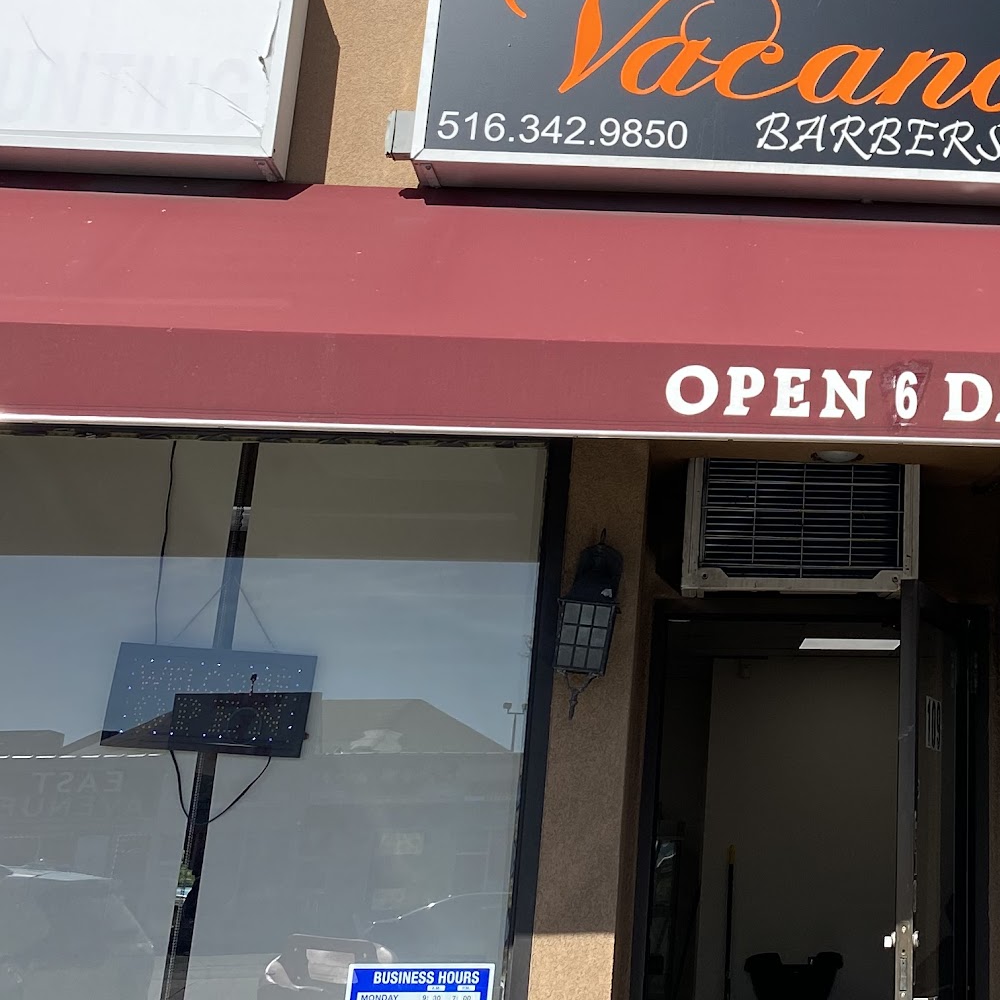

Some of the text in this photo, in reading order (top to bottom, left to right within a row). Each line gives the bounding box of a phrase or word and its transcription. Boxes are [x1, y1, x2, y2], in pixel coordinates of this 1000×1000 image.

[436, 110, 689, 150] 516.342.9850
[665, 364, 873, 421] OPEN
[894, 370, 918, 420] 6
[373, 971, 480, 985] BUSINESS HOURS
